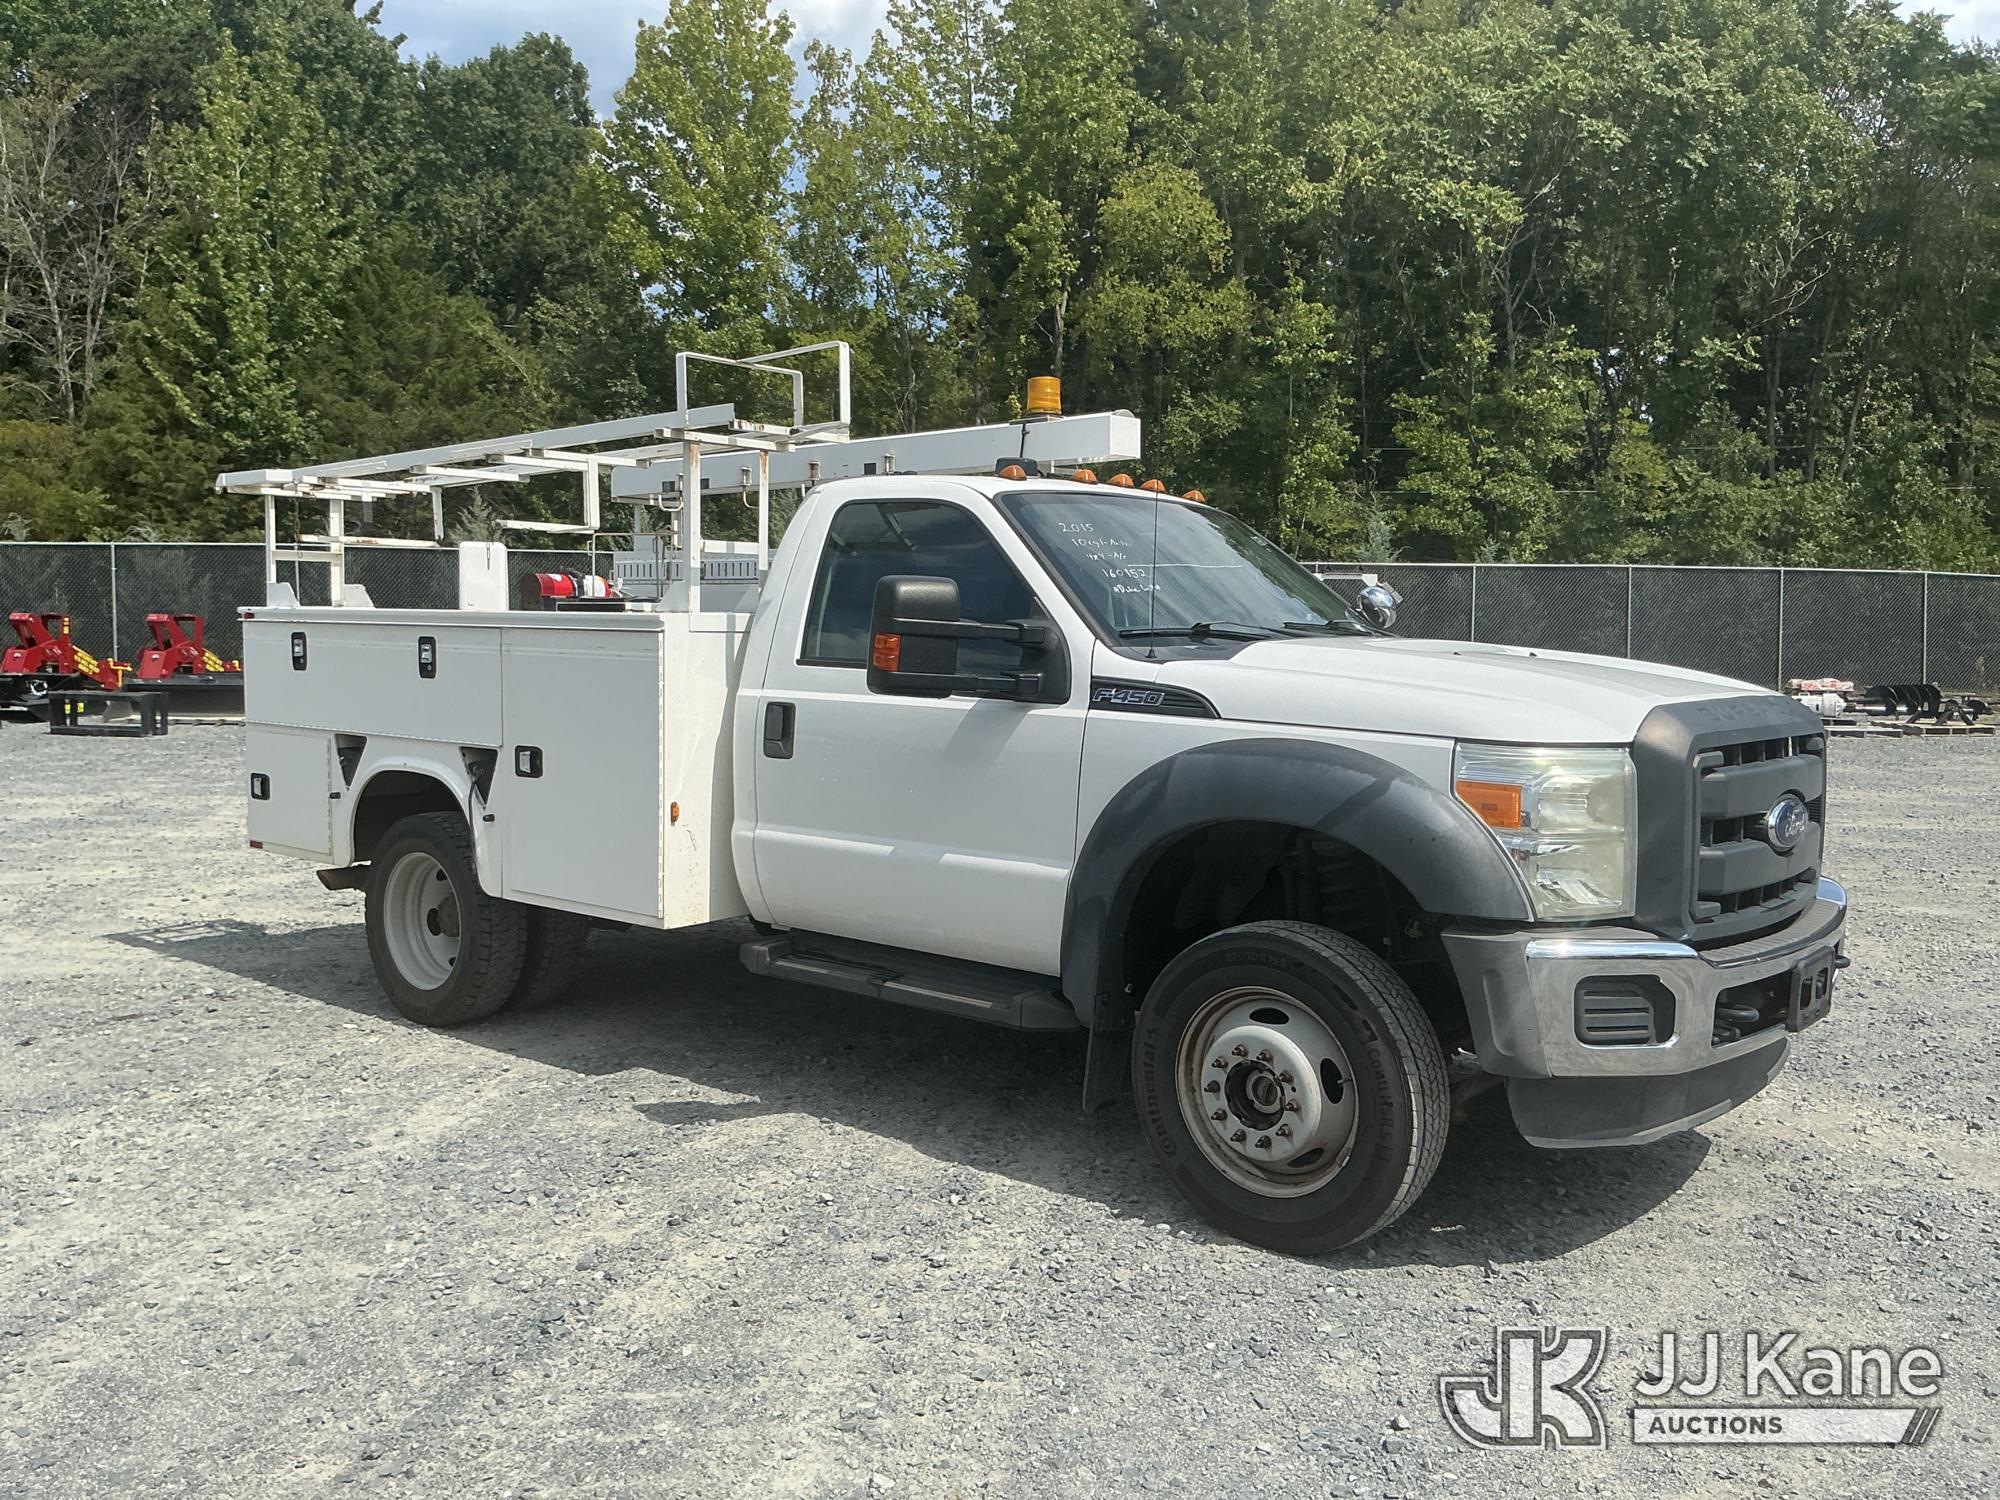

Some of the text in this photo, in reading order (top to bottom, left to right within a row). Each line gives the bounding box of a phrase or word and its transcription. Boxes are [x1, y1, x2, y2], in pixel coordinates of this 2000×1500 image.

[1057, 522, 1094, 533] 2015
[1101, 568, 1148, 579] 160152
[1093, 687, 1165, 706] F-450
[1784, 807, 1806, 838] Ford
